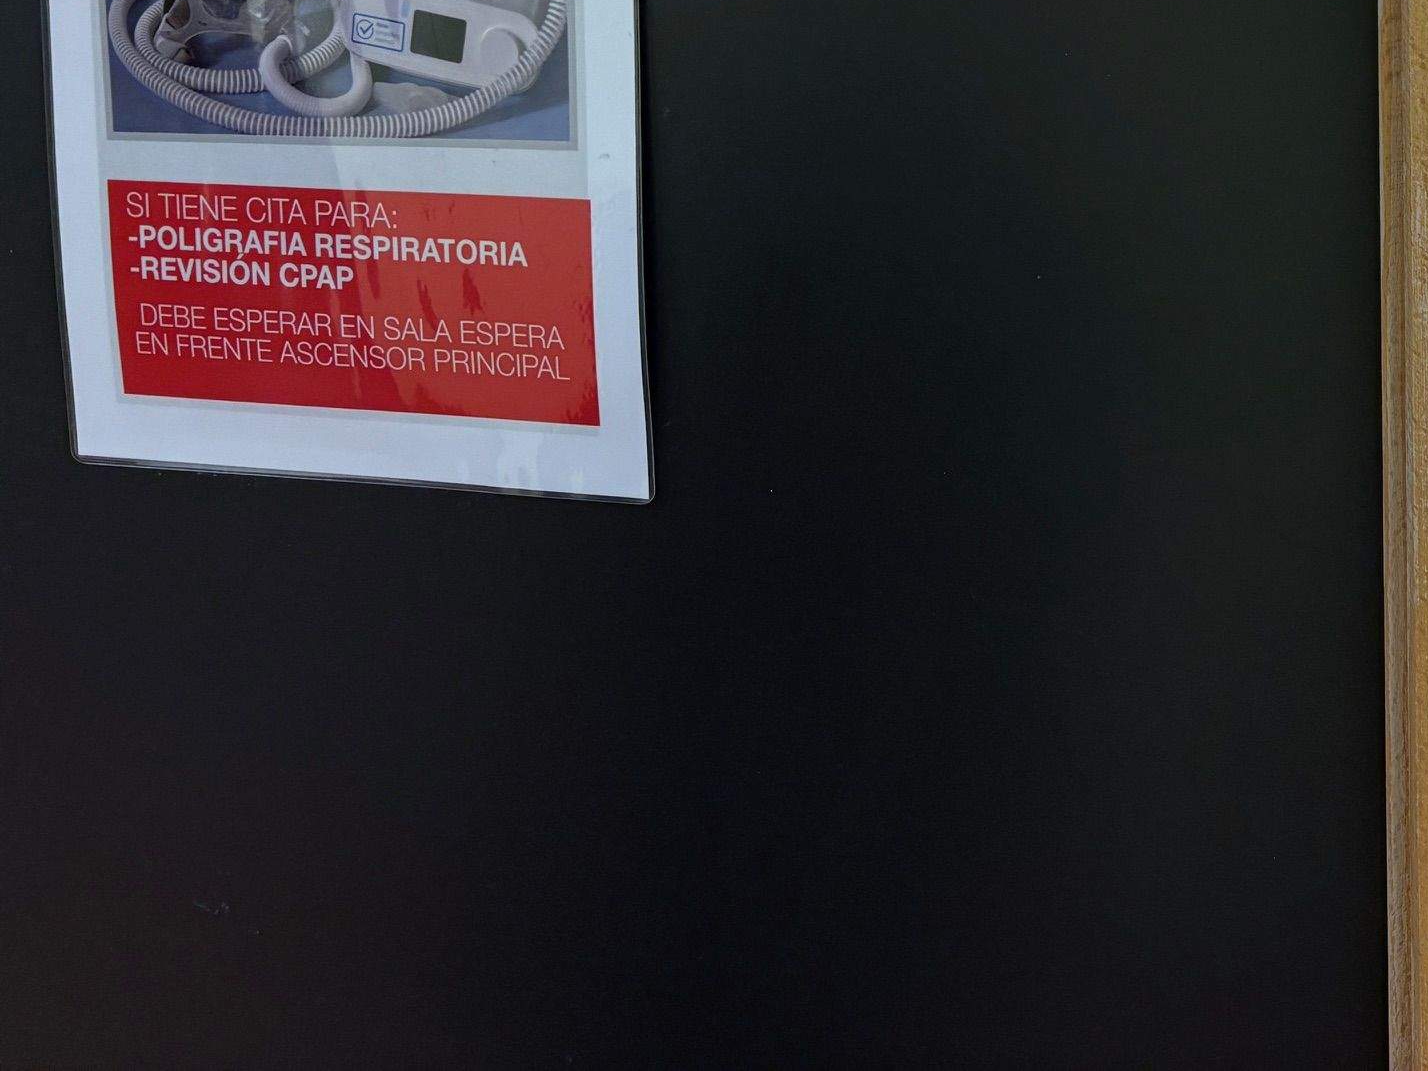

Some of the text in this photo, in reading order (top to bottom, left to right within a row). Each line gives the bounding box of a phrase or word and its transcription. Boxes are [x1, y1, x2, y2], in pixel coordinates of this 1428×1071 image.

[127, 191, 398, 229] SI TIENE CITA PARA:
[128, 224, 528, 267] -POLIGRAFIA RESPIRATORIA
[130, 253, 354, 290] -REVISIÓN CPAP
[140, 303, 565, 350] DEBE ESPERAR EN SALA ESPERA
[135, 331, 570, 380] EN FRENTE ASCENSOR PRINCIPAL
